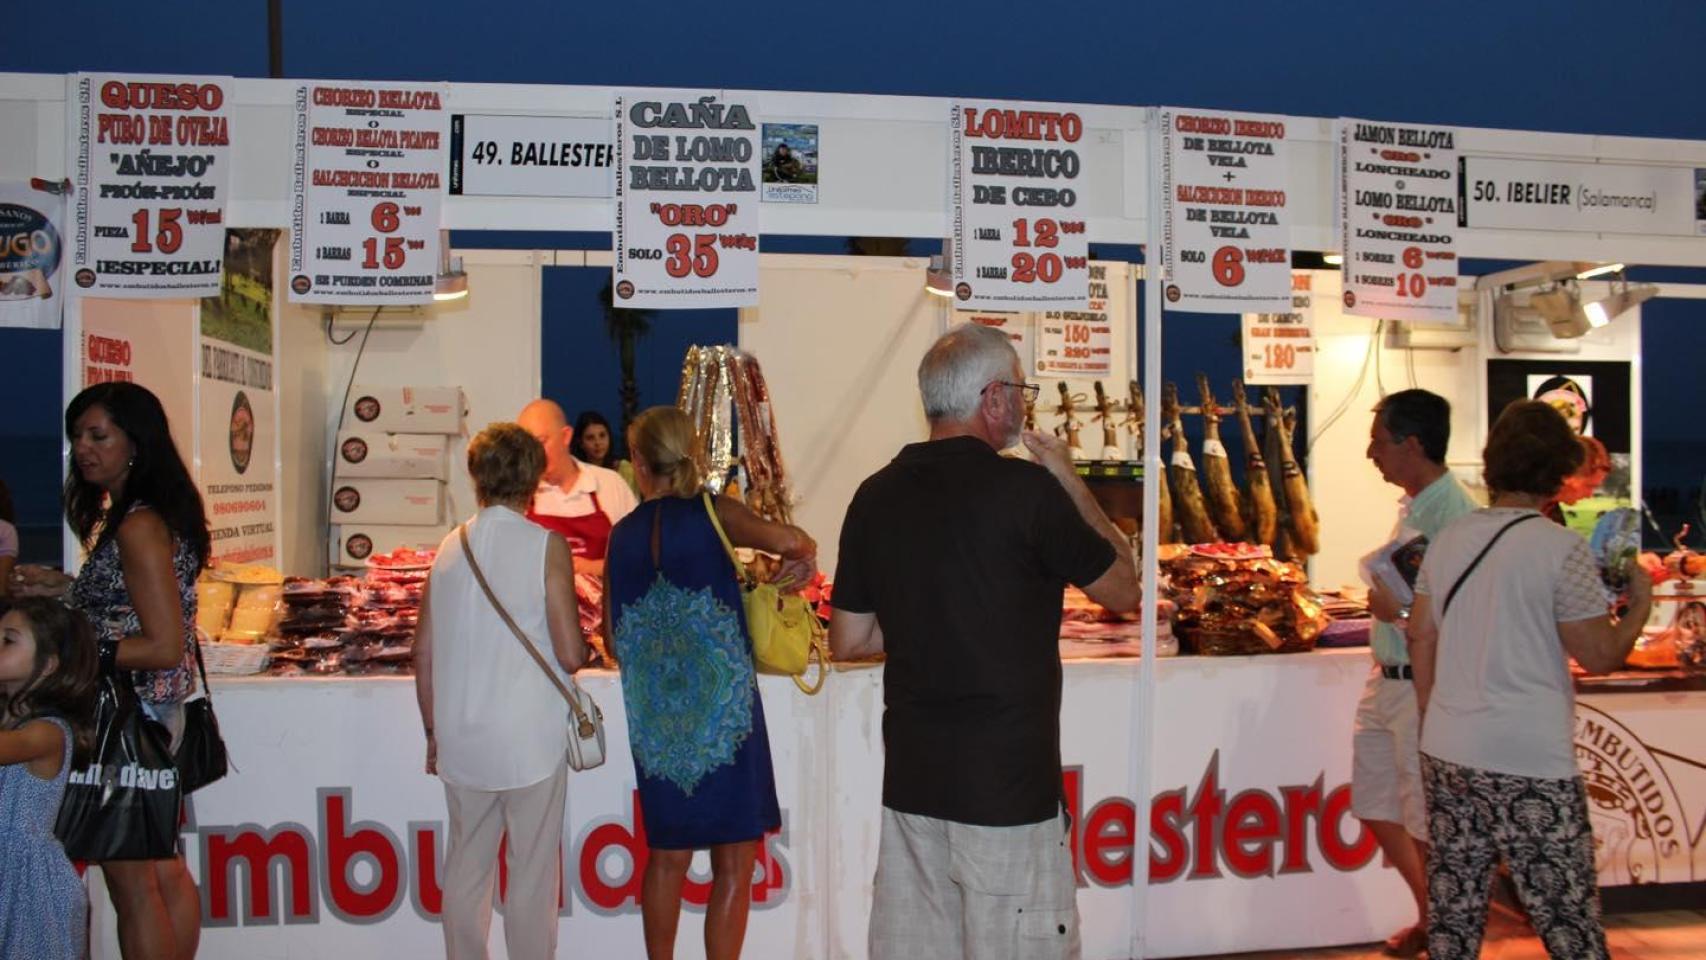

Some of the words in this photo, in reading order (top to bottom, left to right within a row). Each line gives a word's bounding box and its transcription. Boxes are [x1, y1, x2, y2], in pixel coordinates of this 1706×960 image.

[102, 81, 222, 111] QUESO
[314, 87, 374, 108] CHORIZO
[378, 90, 442, 110] BELLOTA
[345, 109, 405, 118] ESPECIAL
[368, 120, 379, 128] O
[630, 96, 756, 130] CAÑA
[964, 108, 1082, 142] LOMITO
[98, 114, 144, 145] PURO
[149, 116, 172, 145] DE
[176, 117, 228, 146] OVEJA
[312, 127, 354, 146] CHORIZO
[356, 128, 398, 148] BELLOTA
[400, 130, 440, 150] PICANTE
[1176, 115, 1231, 135] CHORIZO
[1234, 120, 1285, 139] IBERICO
[1354, 124, 1395, 144] JAMON
[1398, 128, 1454, 150] BELLOTA
[346, 148, 405, 158] ESPECIAL
[472, 141, 502, 165] 49.
[633, 135, 670, 161] DE
[676, 136, 752, 162] LOMO
[1184, 138, 1204, 151] DE
[1208, 139, 1274, 155] BELLOTA
[110, 149, 215, 177] "AÑEJO"
[367, 160, 380, 169] O
[615, 123, 623, 197] Ballesteros
[972, 146, 1080, 178] IBERICO
[1207, 154, 1248, 168] VELA
[1356, 162, 1450, 180] LONCHEADO
[312, 169, 390, 188] SALCHICHON
[392, 172, 440, 190] BELLOTA
[630, 166, 756, 192] BELLOTA
[1222, 171, 1236, 182] +
[1395, 180, 1405, 190] O
[348, 189, 406, 198] ESPECIAL
[973, 185, 1006, 204] DE
[1012, 186, 1076, 207] CEBO
[1177, 184, 1244, 205] SALCHICHON
[1245, 188, 1286, 208] IBERICO
[1355, 190, 1392, 208] LOMO
[1396, 194, 1454, 213] BELLOTA
[1474, 180, 1500, 201] 50.
[1507, 182, 1571, 205] IBELIER
[1576, 184, 1657, 213] (Salamanca)
[326, 212, 350, 224] BARRA
[371, 202, 400, 233] 6
[650, 202, 737, 227] "ORO"
[1186, 208, 1206, 222] DE
[1210, 210, 1279, 225] BELLOTA
[94, 226, 129, 238] PIEZA
[131, 208, 182, 254] 15
[616, 201, 624, 274] Embutidos
[979, 228, 1001, 240] BARRA
[1012, 218, 1058, 248] 12
[1210, 226, 1250, 238] VELA
[1356, 228, 1452, 244] LONCHEADO
[322, 246, 352, 260] BARRAS
[362, 237, 406, 270] 15
[628, 248, 662, 260] SOLO
[665, 233, 719, 278] 35
[1363, 252, 1394, 264] SOBRE
[1402, 246, 1424, 269] 6
[96, 259, 220, 276] ¡ESPECIAL!
[982, 267, 1007, 280] BARRAS
[1012, 252, 1063, 283] 20
[1181, 250, 1206, 263] SOLO
[1212, 245, 1245, 287] 6
[315, 275, 330, 285] SE
[332, 276, 377, 287] PUEDEN
[379, 276, 434, 287] COMBINAR
[1361, 275, 1394, 286] SOBRES
[1396, 272, 1426, 298] 10
[242, 522, 274, 536] VIRTUAL
[1575, 716, 1679, 859] MBUTIDOS
